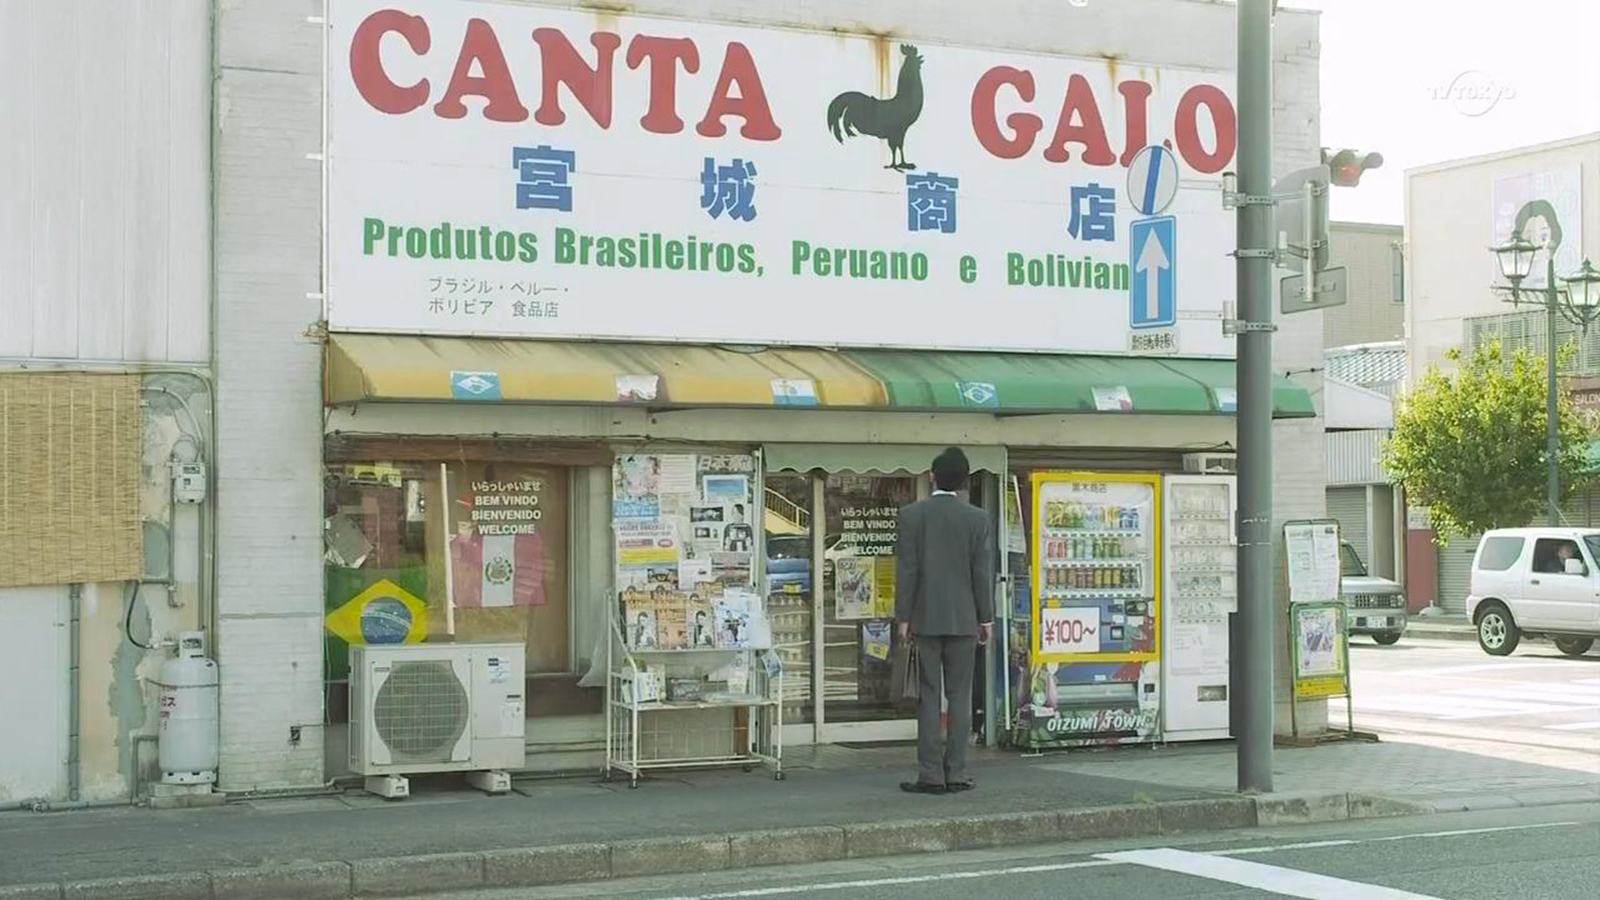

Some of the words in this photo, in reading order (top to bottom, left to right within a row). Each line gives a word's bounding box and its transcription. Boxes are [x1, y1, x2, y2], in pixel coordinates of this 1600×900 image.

[349, 9, 782, 141] CANTA
[970, 66, 1237, 174] GALO
[363, 218, 538, 263] Produtos
[554, 228, 764, 277] Brasileiros,
[792, 240, 929, 280] Peruano
[959, 255, 977, 283] e
[1007, 252, 1129, 290] Bolivian
[511, 299, 559, 318] 食品店
[471, 480, 541, 492] いらっしゃいませ
[474, 495, 501, 506] BEM
[502, 495, 538, 506] VINDO
[471, 509, 542, 521] BIENVENIDO
[840, 506, 898, 517] いらっしゃいませ
[478, 523, 535, 535] WELCOME
[843, 519, 864, 530] BEM
[865, 519, 896, 530] VINDO
[840, 532, 899, 543] BIENVENIDO
[1046, 716, 1098, 732] OIZUMI
[1101, 715, 1147, 731] TOWN
